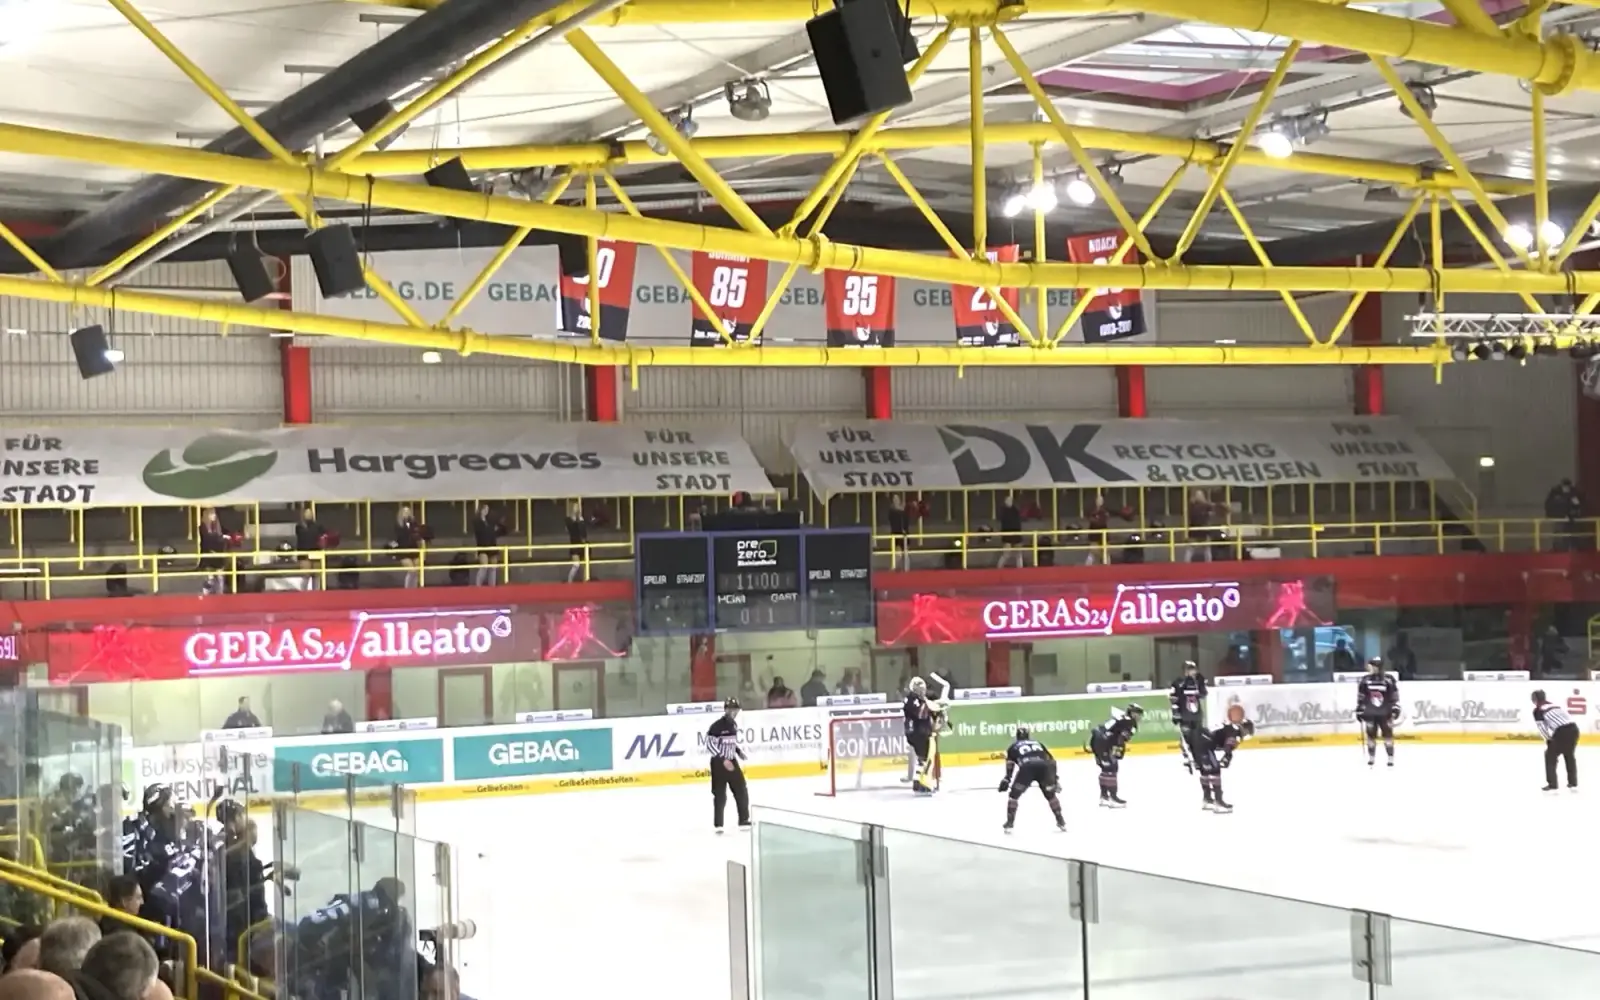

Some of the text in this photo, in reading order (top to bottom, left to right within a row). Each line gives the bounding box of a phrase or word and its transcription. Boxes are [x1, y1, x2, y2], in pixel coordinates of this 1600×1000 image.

[342, 281, 455, 300] EBG.DE
[709, 266, 748, 308] 85
[843, 275, 878, 316] 35
[779, 288, 825, 306] GEB
[5, 436, 62, 451] FÜR
[644, 430, 693, 444] FÜR
[827, 426, 875, 444] FÜR
[632, 450, 729, 466] UNSERE
[819, 448, 912, 464] UNSERE
[937, 424, 1137, 486] DK
[1113, 442, 1276, 461] RECYCLING
[307, 448, 601, 480] Hargreaves
[1146, 462, 1322, 483] & ROHEISEN
[656, 474, 732, 490] STADT
[843, 471, 914, 487] STADT
[2, 485, 95, 503] STADT
[737, 540, 758, 551] pre
[737, 550, 767, 559] zero
[1120, 592, 1224, 625] alleato
[361, 621, 492, 657] alleato
[697, 723, 822, 746] MCO LANKES
[958, 722, 977, 737] Ihr
[488, 738, 573, 766] GEBAG
[311, 750, 401, 777] GEBAG
